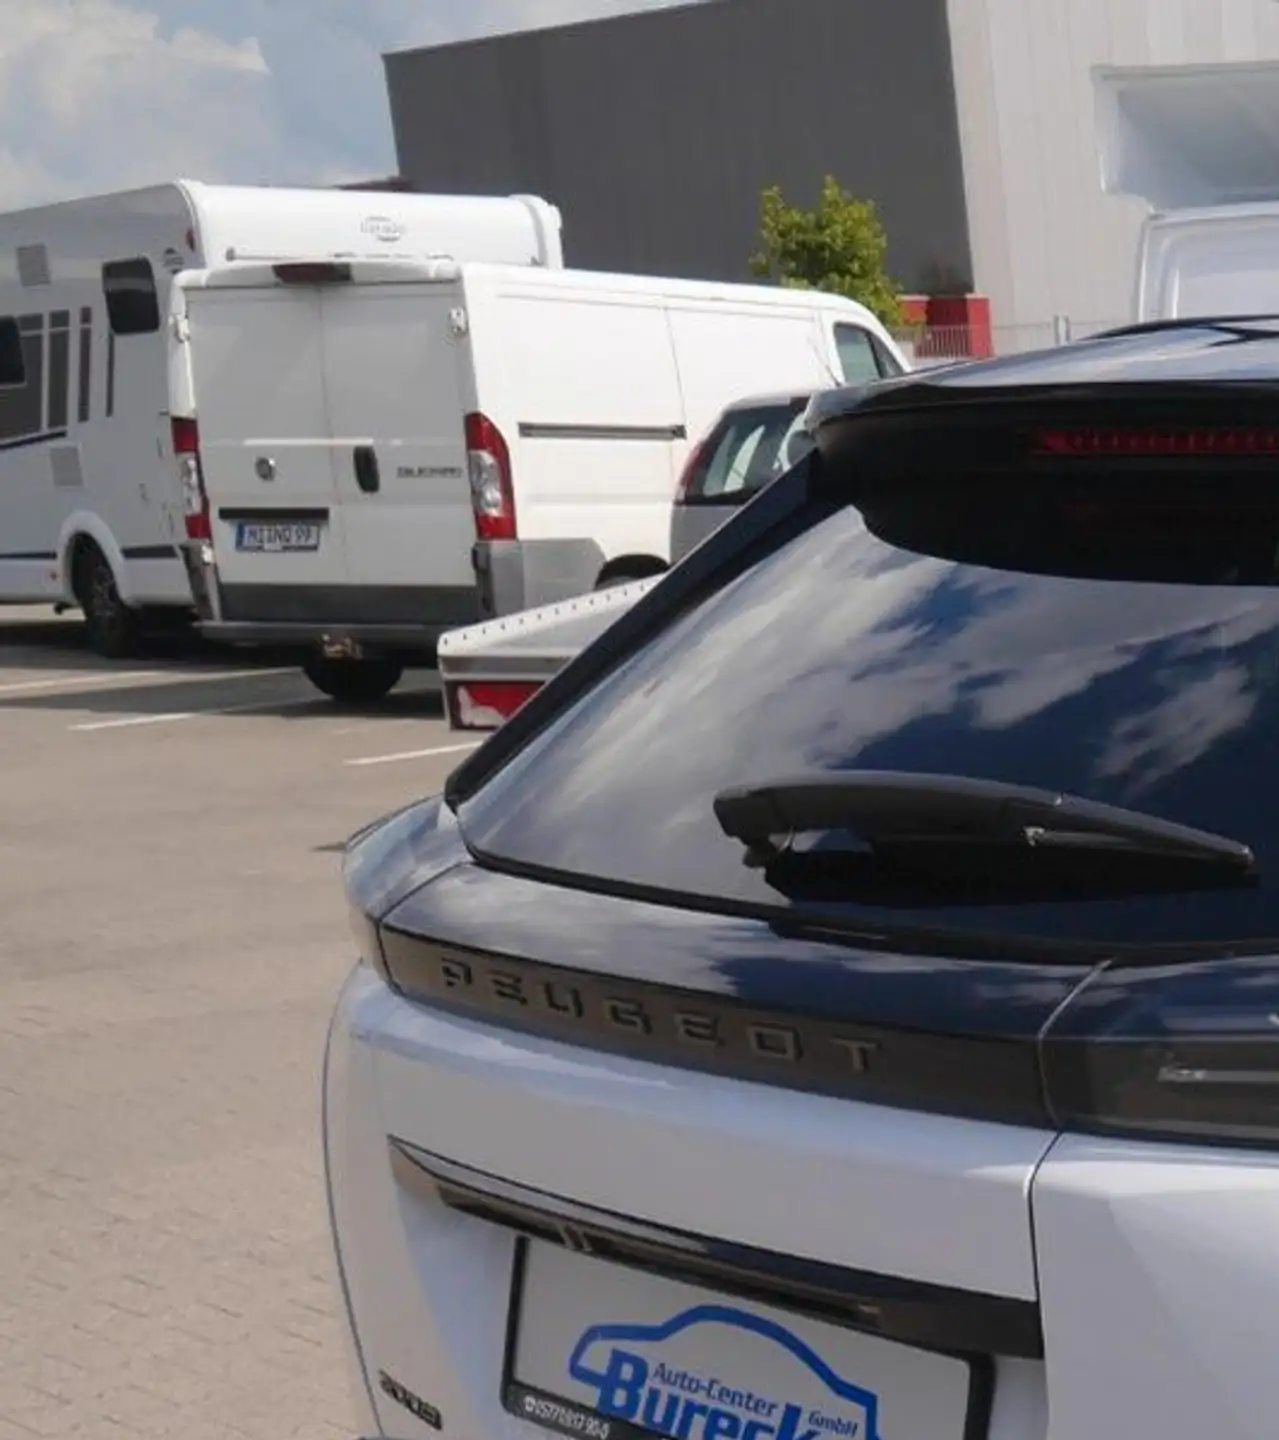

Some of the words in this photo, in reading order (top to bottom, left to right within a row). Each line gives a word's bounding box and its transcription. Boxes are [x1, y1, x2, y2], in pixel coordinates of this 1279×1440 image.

[440, 957, 881, 1074] PEUGEOT
[653, 1362, 778, 1417] Auto-Center
[808, 1410, 858, 1436] GmbH
